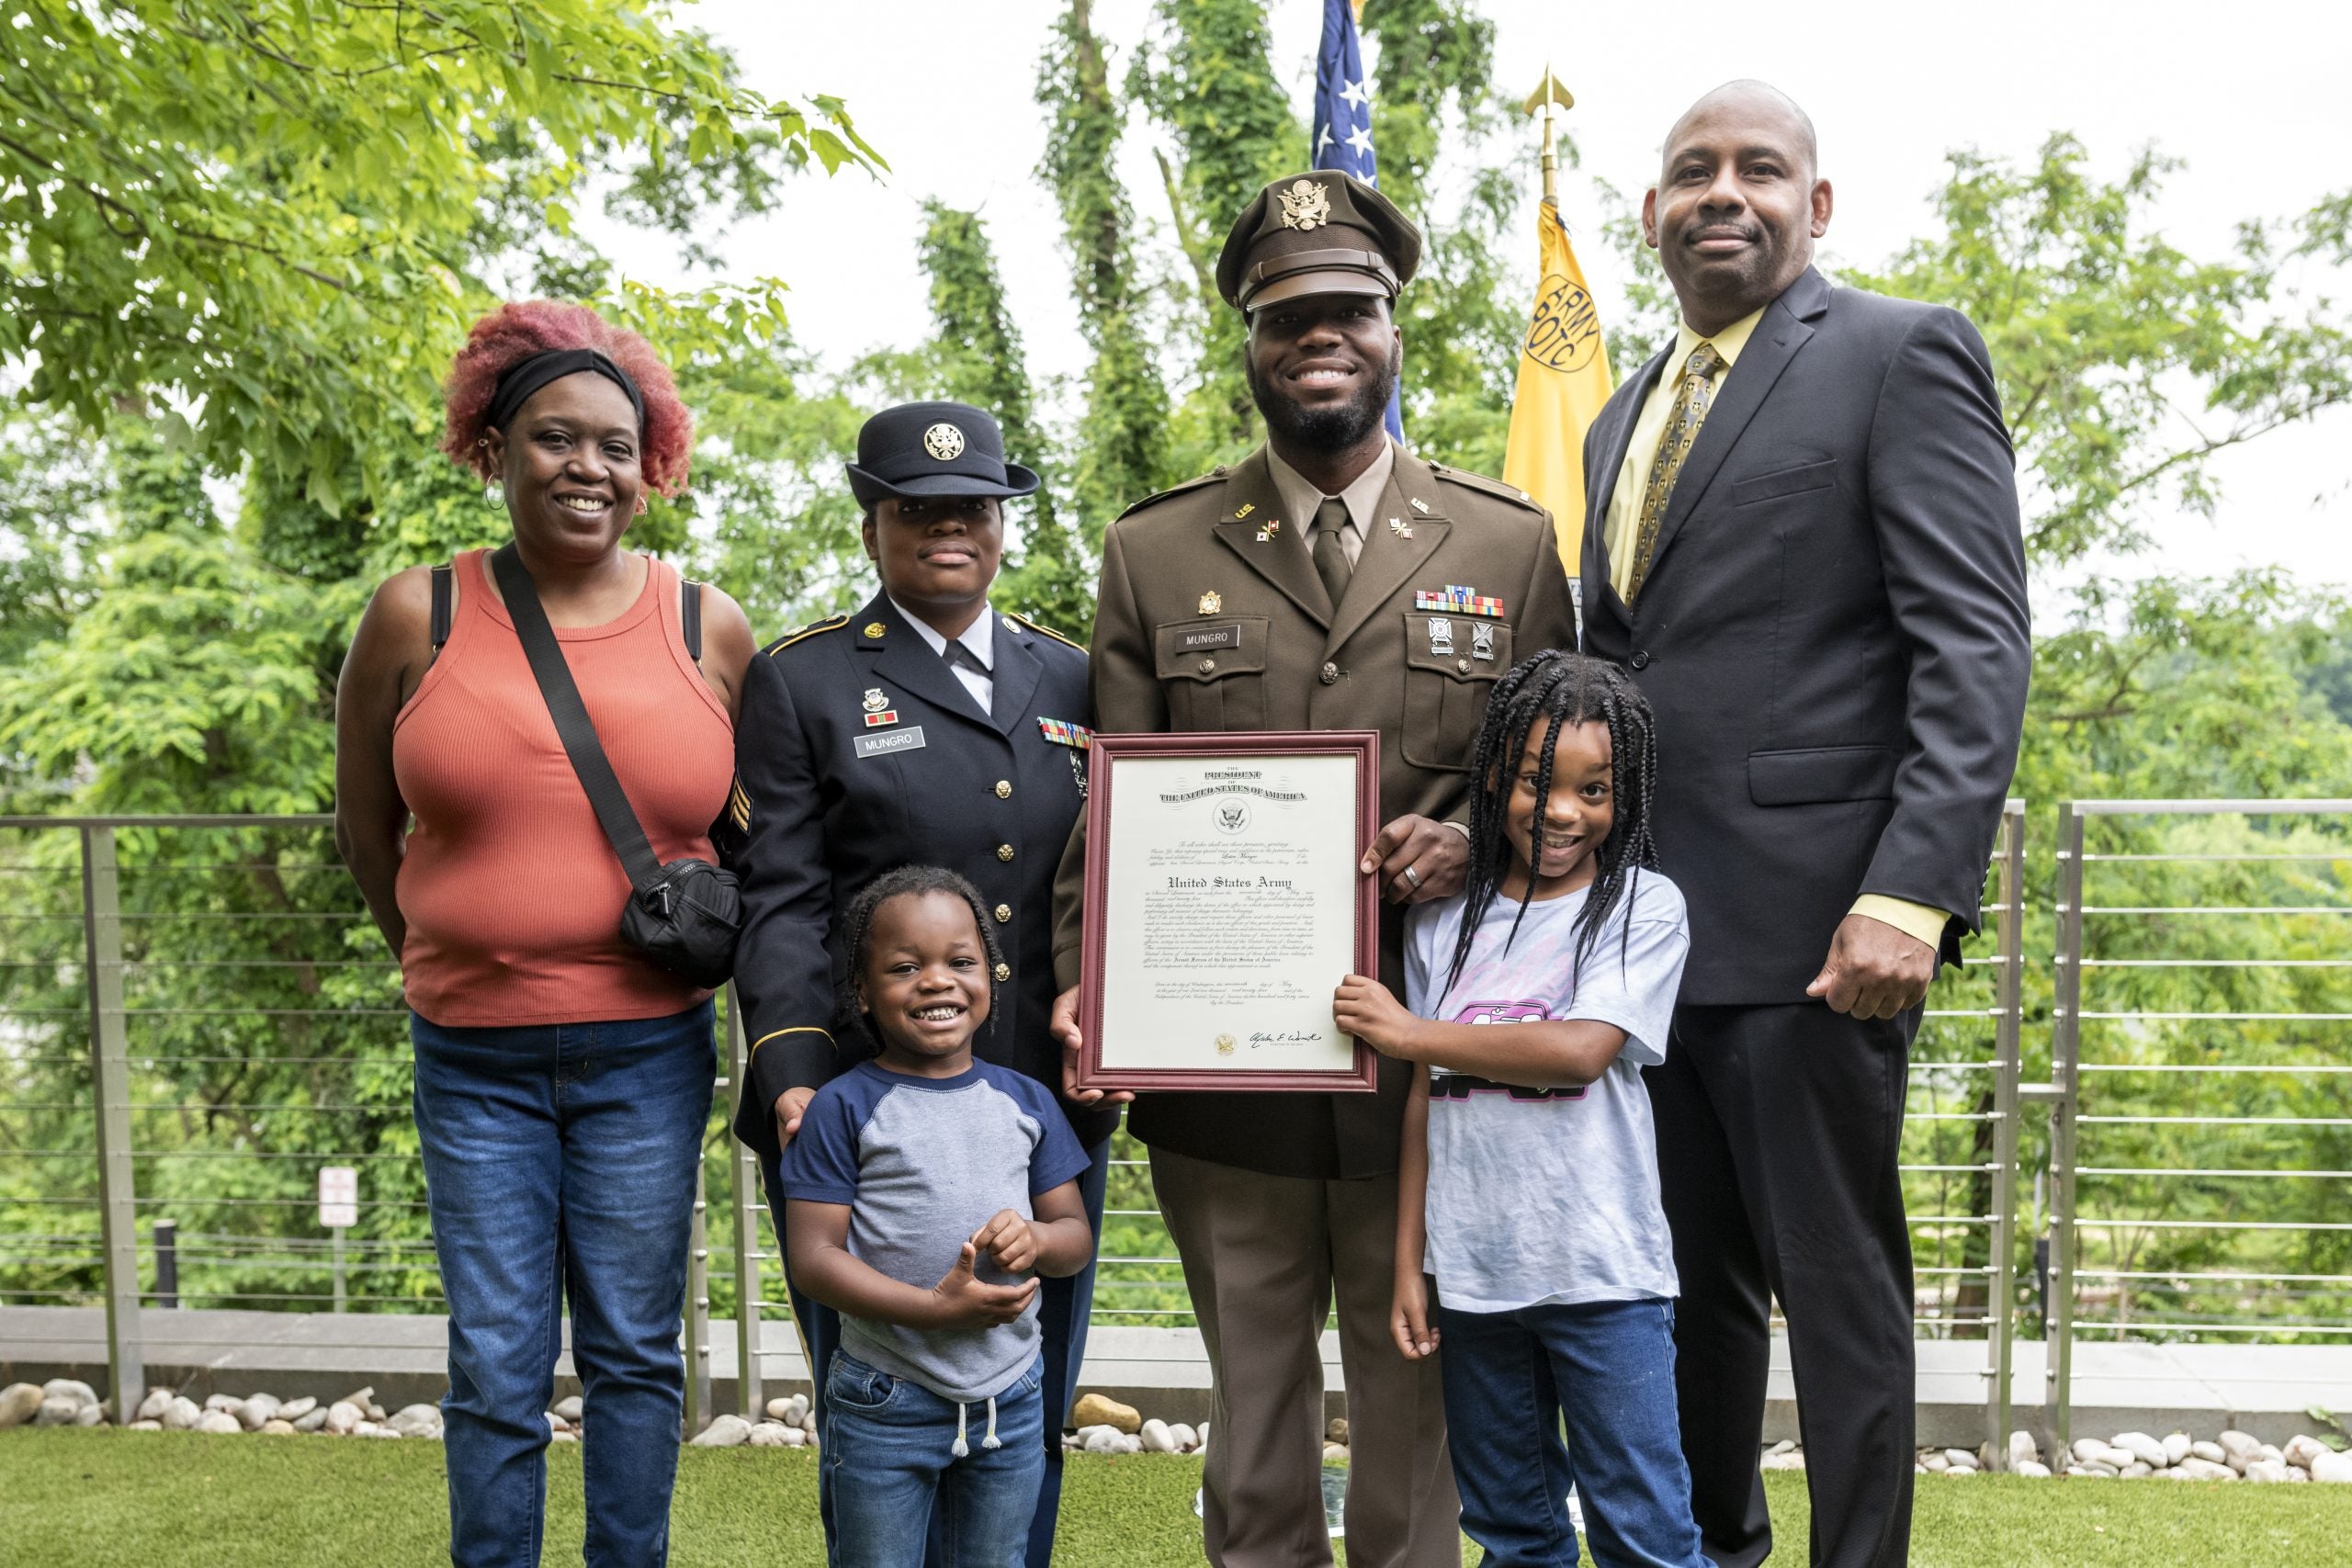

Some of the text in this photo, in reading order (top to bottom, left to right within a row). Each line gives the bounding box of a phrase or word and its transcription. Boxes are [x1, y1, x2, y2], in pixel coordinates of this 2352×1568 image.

[1547, 283, 1598, 344] ARMY
[1529, 301, 1575, 366] ROTC
[1186, 632, 1227, 646] MUNGRO
[865, 734, 912, 750] MUNGRO
[1204, 772, 1261, 780] PRESIDENT
[1159, 794, 1180, 803] THE
[1180, 787, 1215, 802] UNITED
[1215, 784, 1250, 794] STATES
[1263, 790, 1307, 801] AMERICA
[1168, 876, 1292, 890] United States Army
